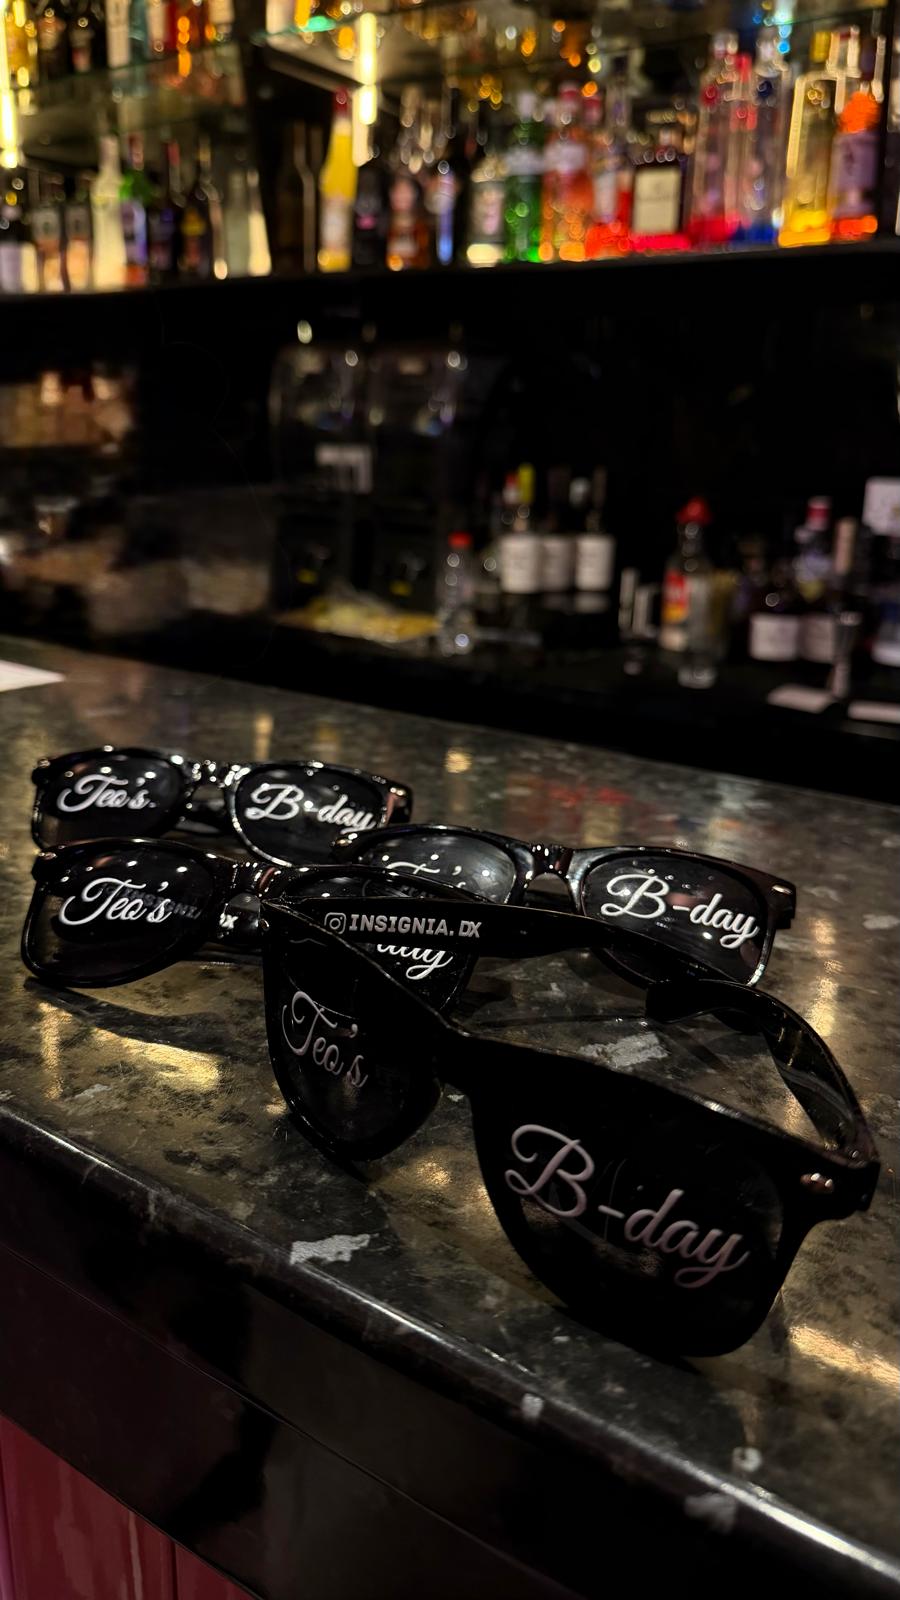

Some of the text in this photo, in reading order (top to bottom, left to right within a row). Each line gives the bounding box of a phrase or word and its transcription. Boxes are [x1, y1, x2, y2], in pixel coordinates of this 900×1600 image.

[56, 773, 377, 835] Teo's B-day
[58, 876, 173, 926] Teo's
[600, 873, 761, 950] B-day
[281, 990, 750, 1289] Teo's B-day
